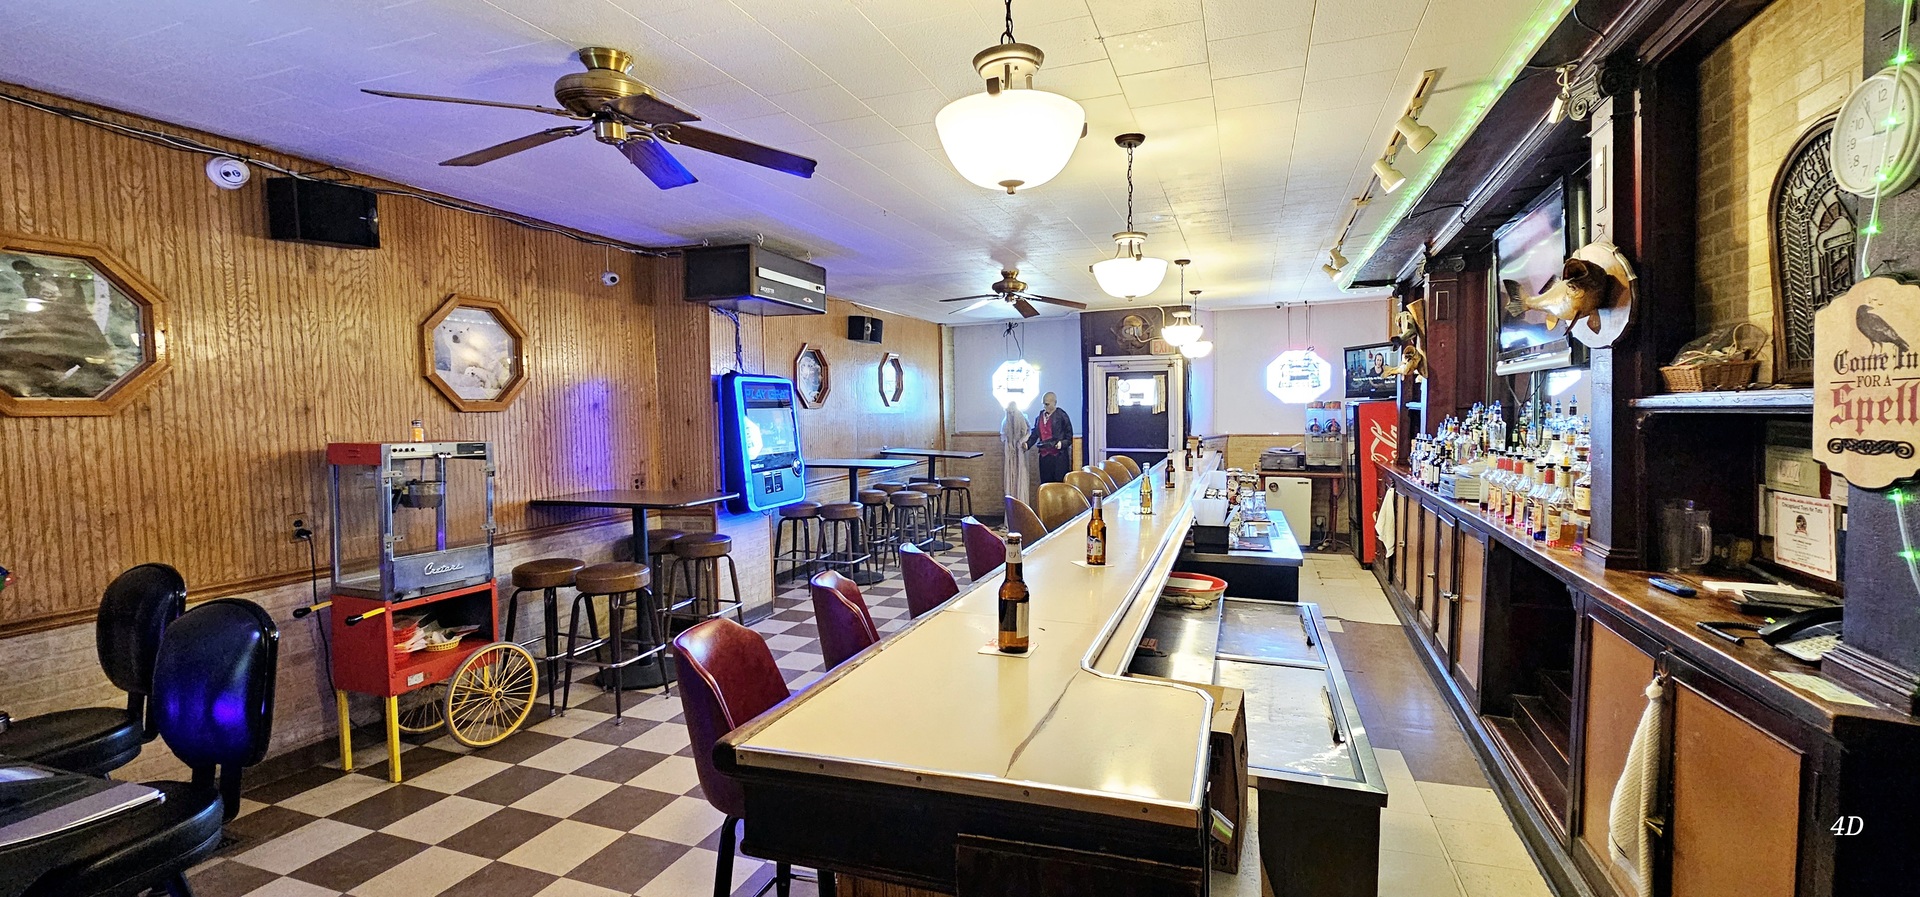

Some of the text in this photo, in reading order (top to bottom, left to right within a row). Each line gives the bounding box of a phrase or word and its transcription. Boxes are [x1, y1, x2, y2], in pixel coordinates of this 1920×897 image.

[1878, 88, 1888, 103] 12
[1855, 117, 1865, 132] 10
[1849, 137, 1857, 150] 9
[1853, 154, 1860, 167] 8
[1862, 165, 1868, 177] 7
[1833, 346, 1919, 375] Come In
[1856, 374, 1892, 388] FOR A
[1829, 381, 1920, 436] Spell
